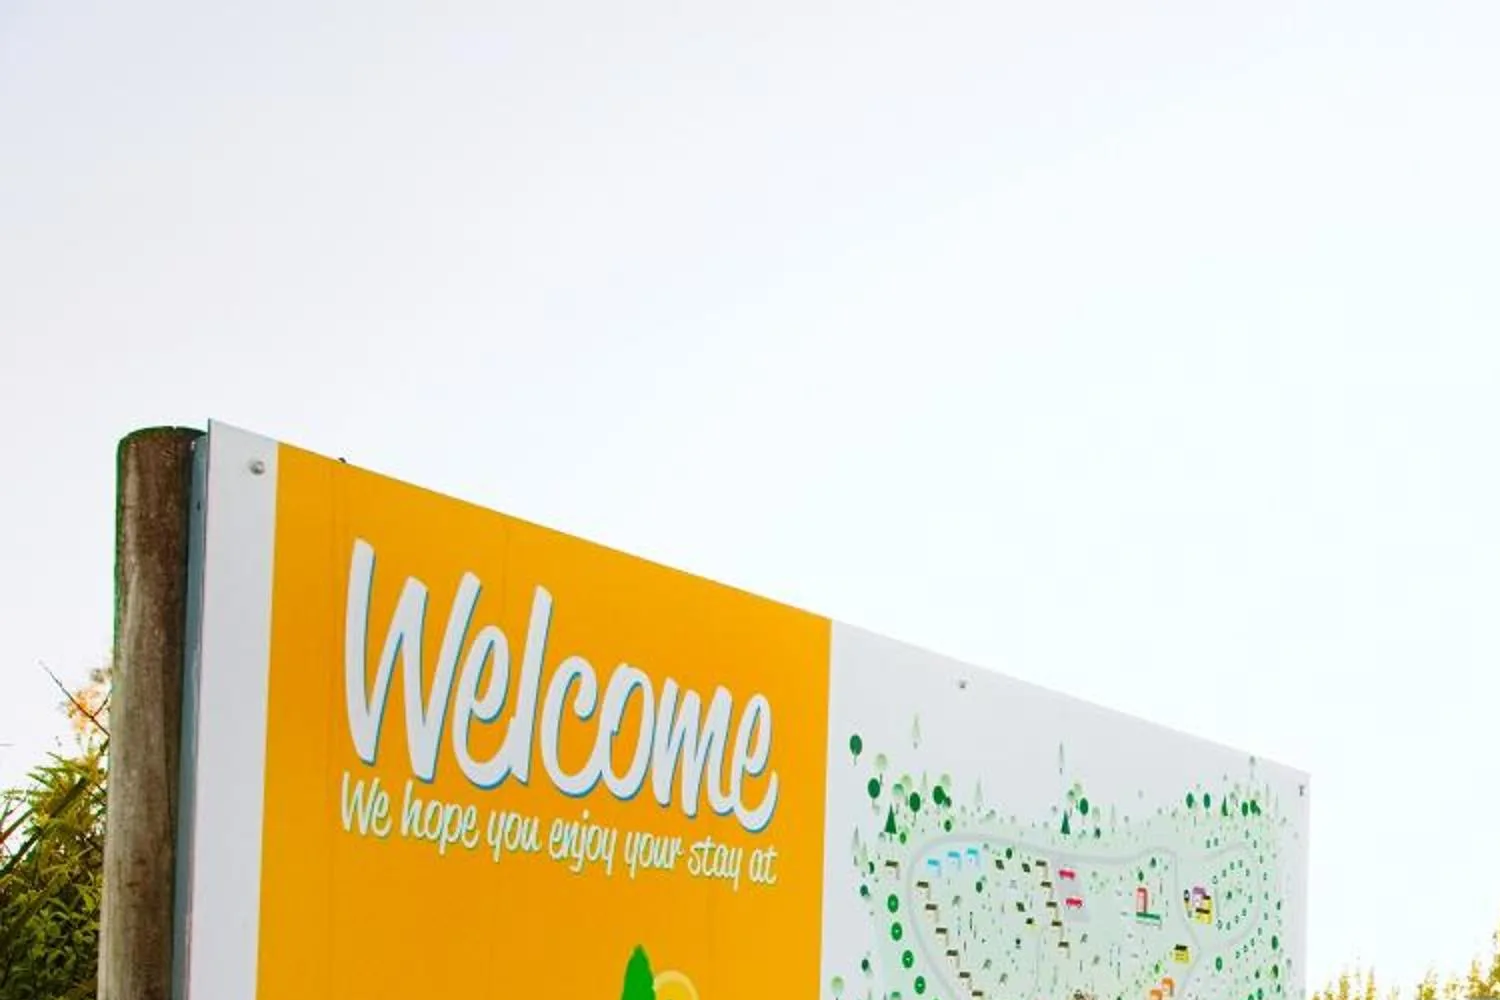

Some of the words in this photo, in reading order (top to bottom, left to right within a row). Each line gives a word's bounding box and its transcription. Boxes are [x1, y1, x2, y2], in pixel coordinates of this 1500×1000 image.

[344, 536, 779, 832] Welcome
[341, 771, 393, 838] We
[400, 779, 480, 855] hope
[486, 809, 542, 863] you
[549, 809, 618, 875] enjoy
[624, 830, 684, 880] your
[687, 836, 743, 892] stay
[749, 845, 778, 885] at
